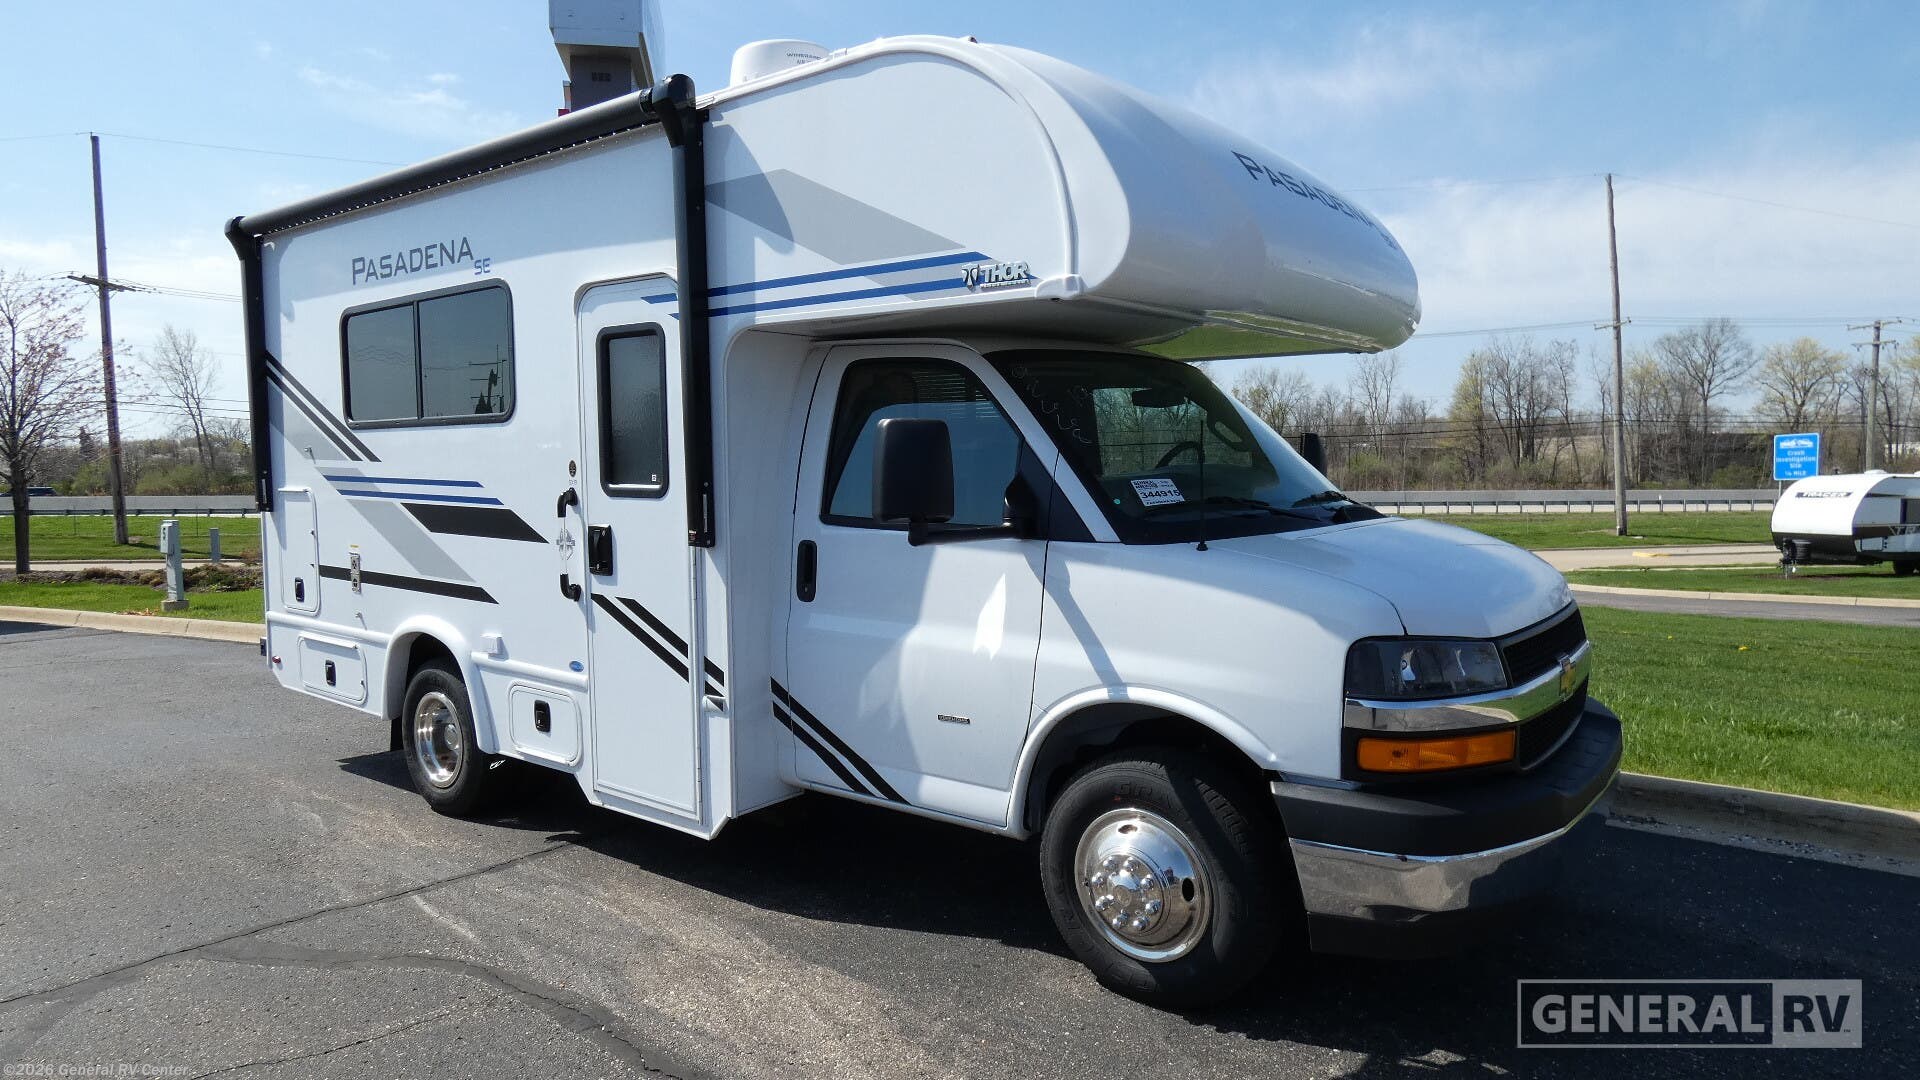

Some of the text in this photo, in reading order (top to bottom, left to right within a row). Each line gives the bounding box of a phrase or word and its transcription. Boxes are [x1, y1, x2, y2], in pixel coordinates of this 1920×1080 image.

[1231, 150, 1376, 227] PASADENA
[352, 236, 491, 285] PASADENA SE
[980, 261, 1029, 283] THOR
[1139, 489, 1181, 499] 344915
